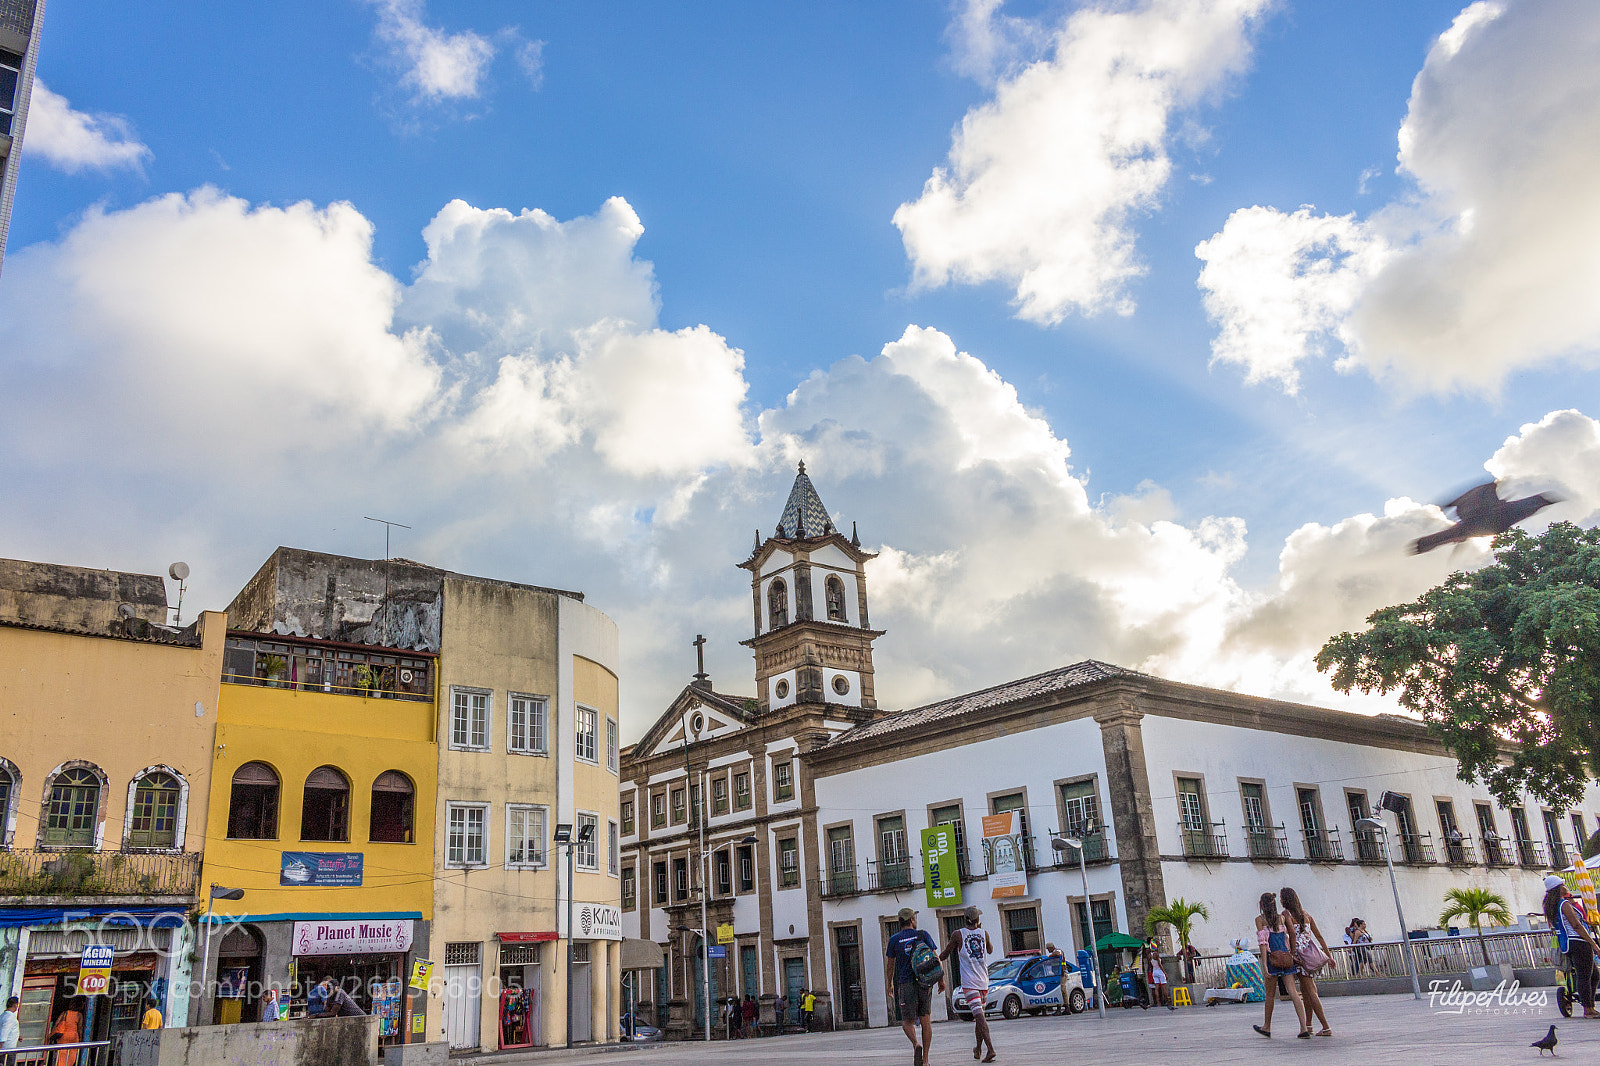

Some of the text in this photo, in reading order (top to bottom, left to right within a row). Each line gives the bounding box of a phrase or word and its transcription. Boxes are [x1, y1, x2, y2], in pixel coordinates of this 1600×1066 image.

[937, 832, 948, 856] VOU
[316, 924, 392, 940] Planet Music
[84, 946, 112, 958] ÁGUA
